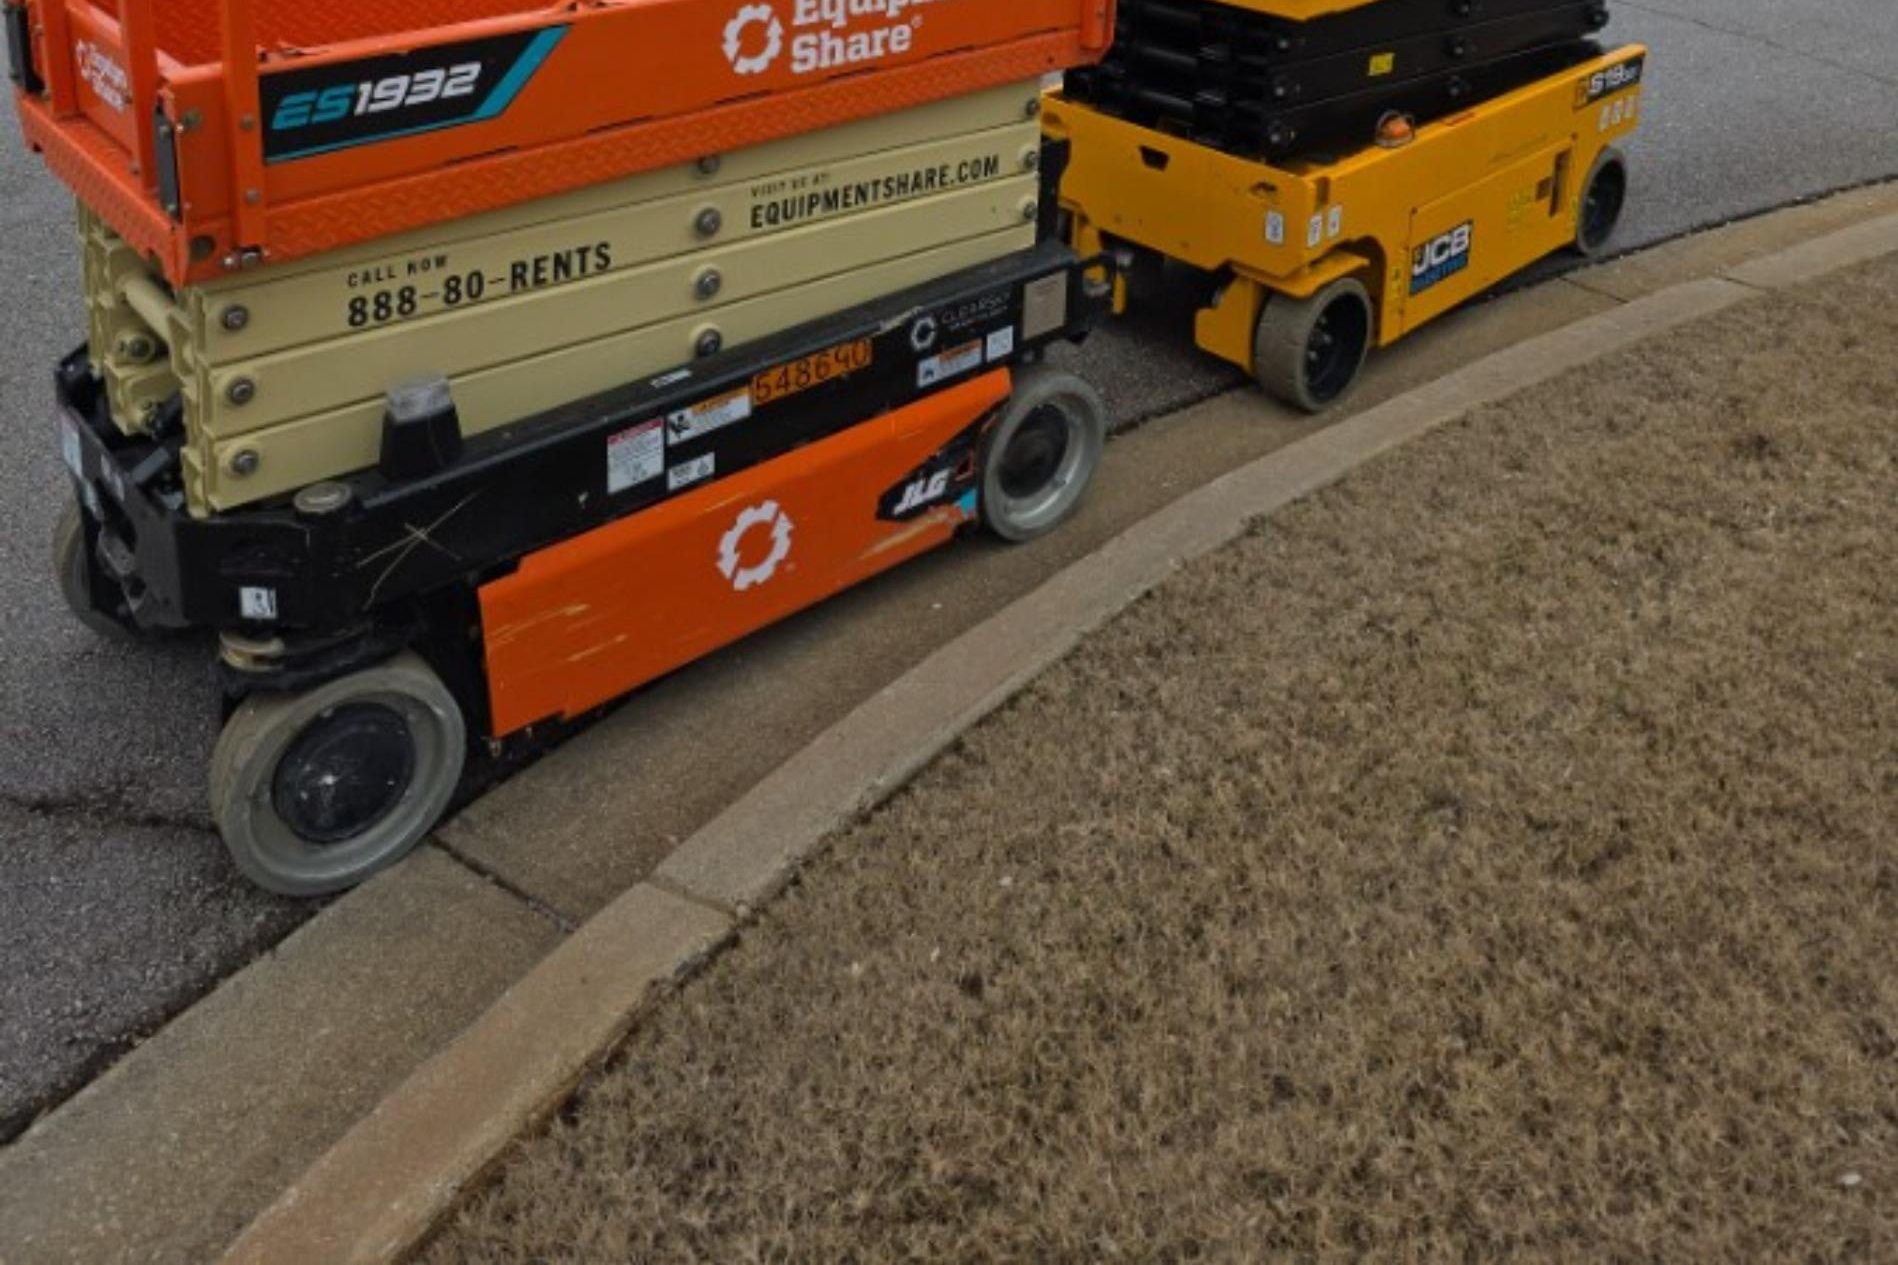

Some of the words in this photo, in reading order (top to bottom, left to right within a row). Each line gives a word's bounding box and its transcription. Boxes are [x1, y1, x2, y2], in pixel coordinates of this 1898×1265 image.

[271, 61, 482, 131] ES1932
[751, 154, 999, 229] EQUIPMENTSHARE.COM
[347, 265, 398, 288] CALL
[406, 254, 449, 276] NOW
[1411, 223, 1471, 276] JCB
[348, 241, 613, 328] 888-80-RENTS
[892, 467, 953, 516] JLG
